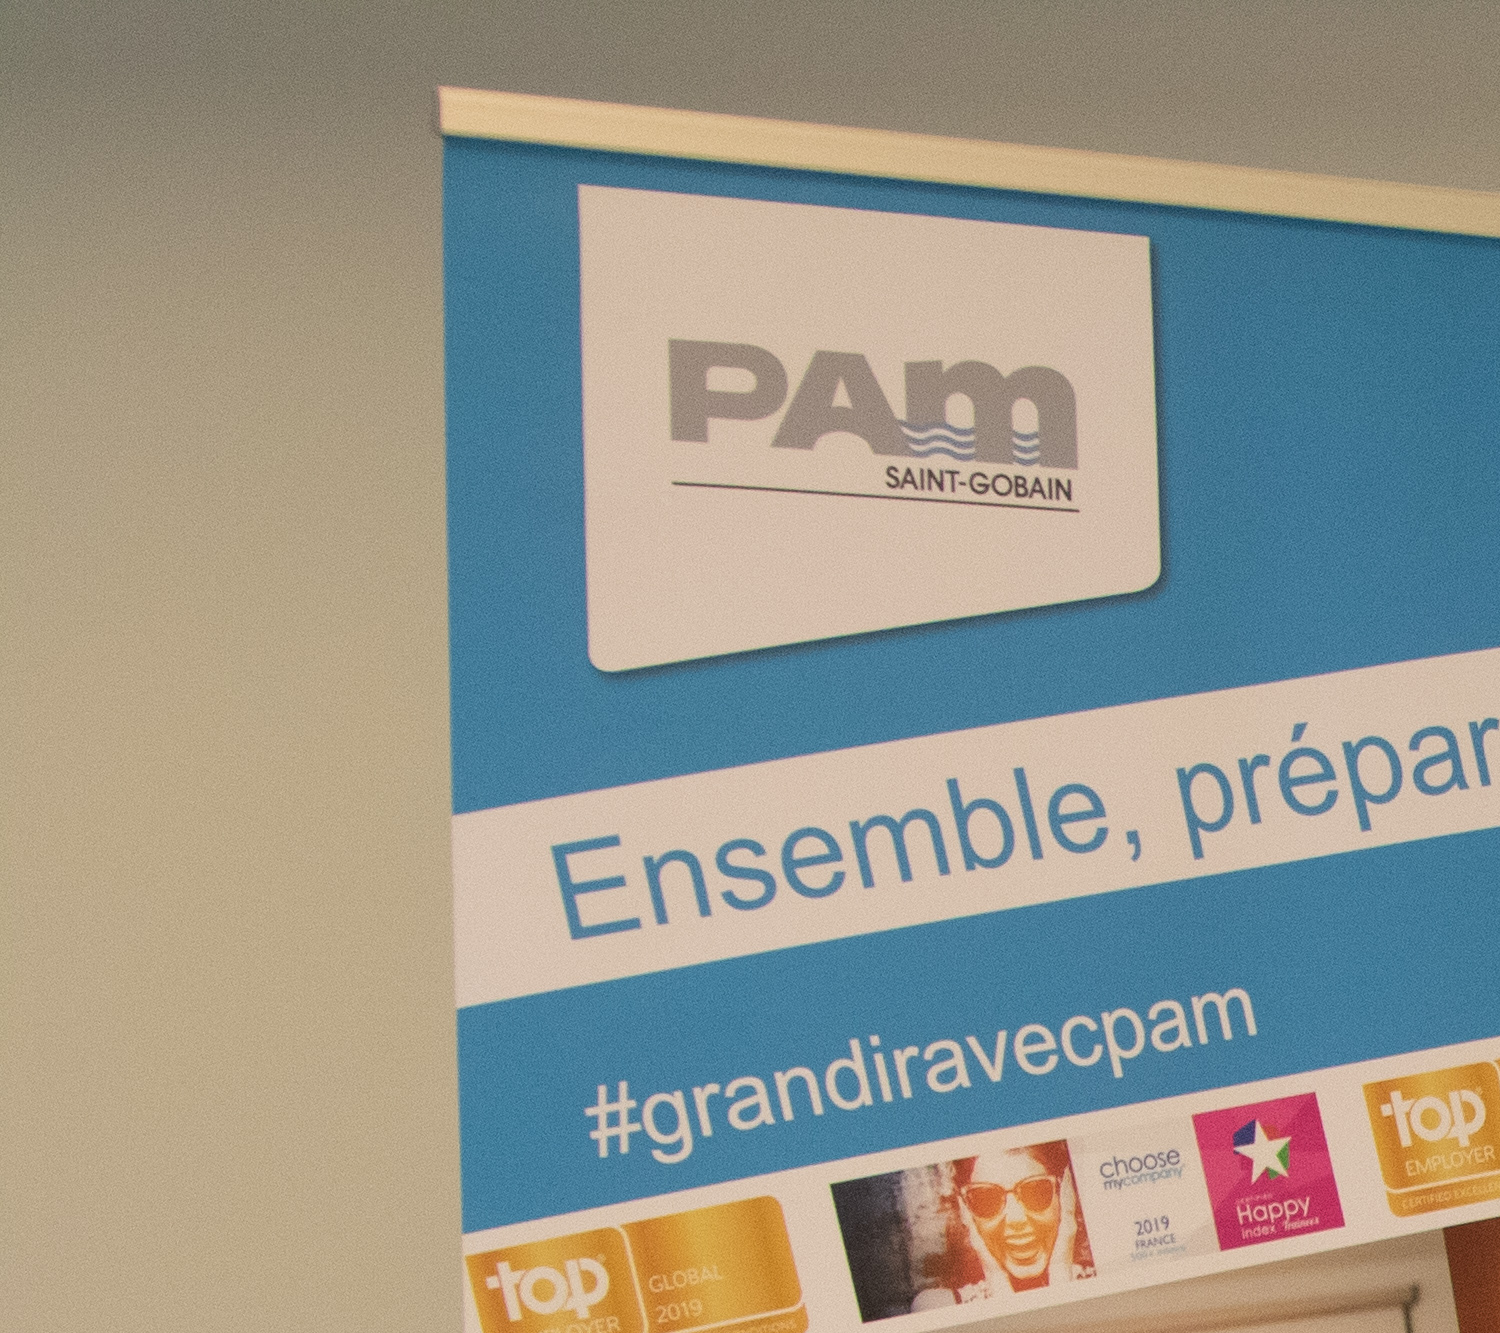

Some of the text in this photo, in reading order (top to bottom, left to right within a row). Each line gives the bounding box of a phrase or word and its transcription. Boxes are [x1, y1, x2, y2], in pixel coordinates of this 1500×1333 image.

[886, 465, 1073, 502] SAINT-GOBAIN
[551, 766, 1144, 940] Ensemble,
[585, 987, 1258, 1164] #grandiravecpam
[1381, 1089, 1487, 1148] top
[1100, 1149, 1181, 1179] choose
[1404, 1145, 1497, 1178] EMPLOYER
[1103, 1165, 1184, 1190] mycompany
[1236, 1196, 1311, 1225] Happy
[1134, 1215, 1171, 1237] 2019
[1135, 1233, 1177, 1251] FRANCE
[485, 1257, 612, 1322] top
[648, 1265, 725, 1293] GLOBAL
[656, 1300, 704, 1325] 2019
